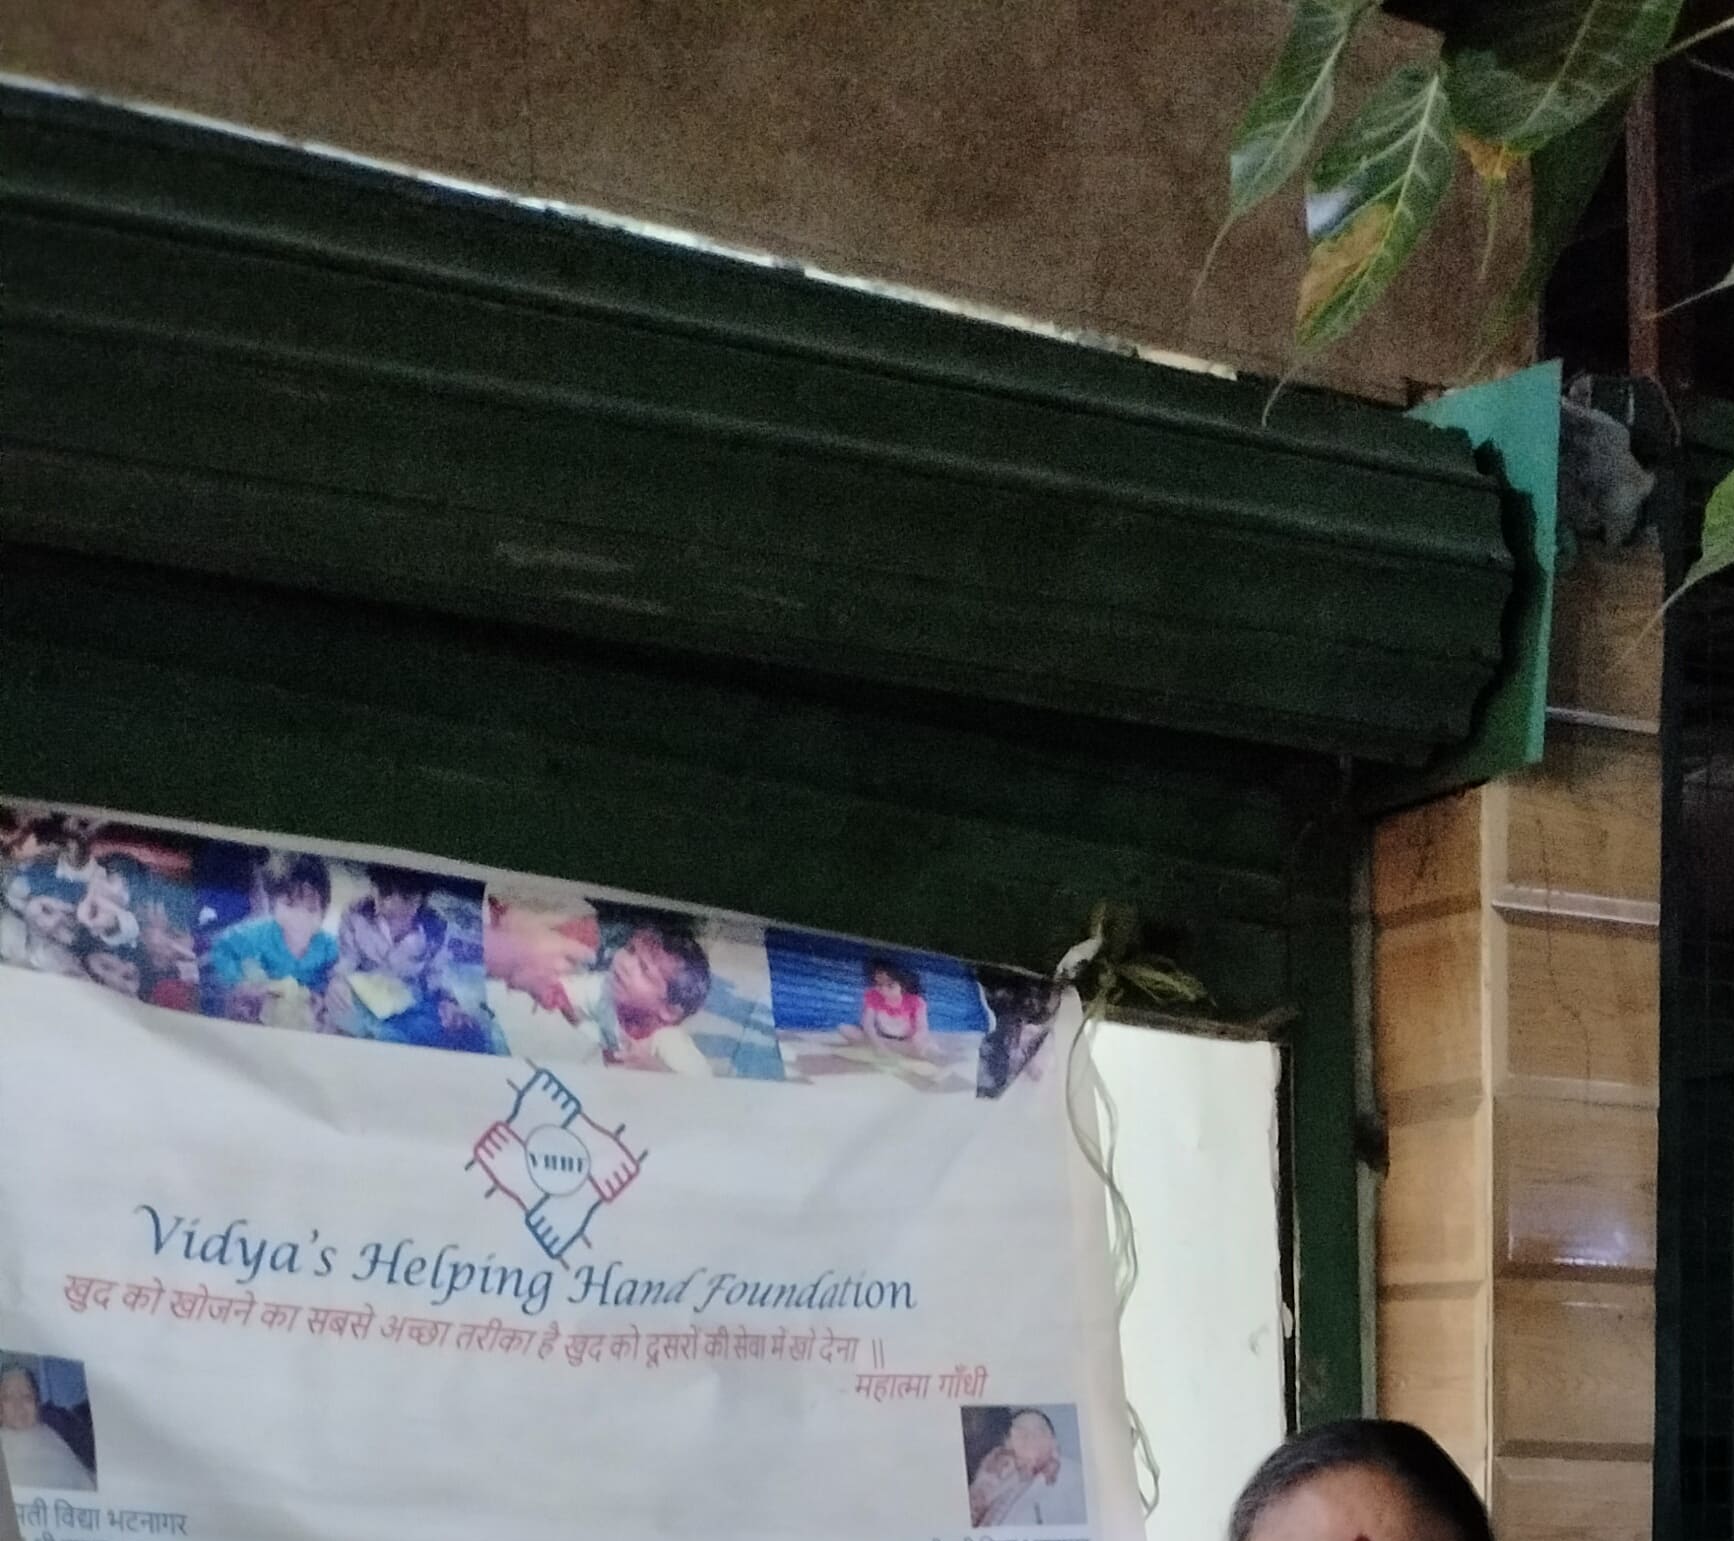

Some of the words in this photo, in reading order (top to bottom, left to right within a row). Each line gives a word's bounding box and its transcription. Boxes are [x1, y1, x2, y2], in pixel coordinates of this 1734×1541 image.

[136, 1204, 338, 1285] Vidya's
[352, 1238, 553, 1316] Helping
[567, 1260, 705, 1309] Hand
[694, 1268, 918, 1314] Foundation
[63, 1273, 119, 1313] खुद
[121, 1277, 164, 1316] को
[169, 1283, 257, 1327] खोजने
[260, 1303, 302, 1332] का
[307, 1302, 377, 1340] सबसे
[455, 1317, 537, 1356] तरीका
[537, 1320, 561, 1361] है
[564, 1333, 608, 1368] खुद
[609, 1323, 641, 1361] को
[703, 1325, 730, 1361] की
[733, 1324, 767, 1361] सेवा
[819, 1327, 860, 1363] देना
[855, 1373, 931, 1402] महात्मा
[54, 1498, 101, 1531] विद्या
[107, 1508, 189, 1537] भटनागर
